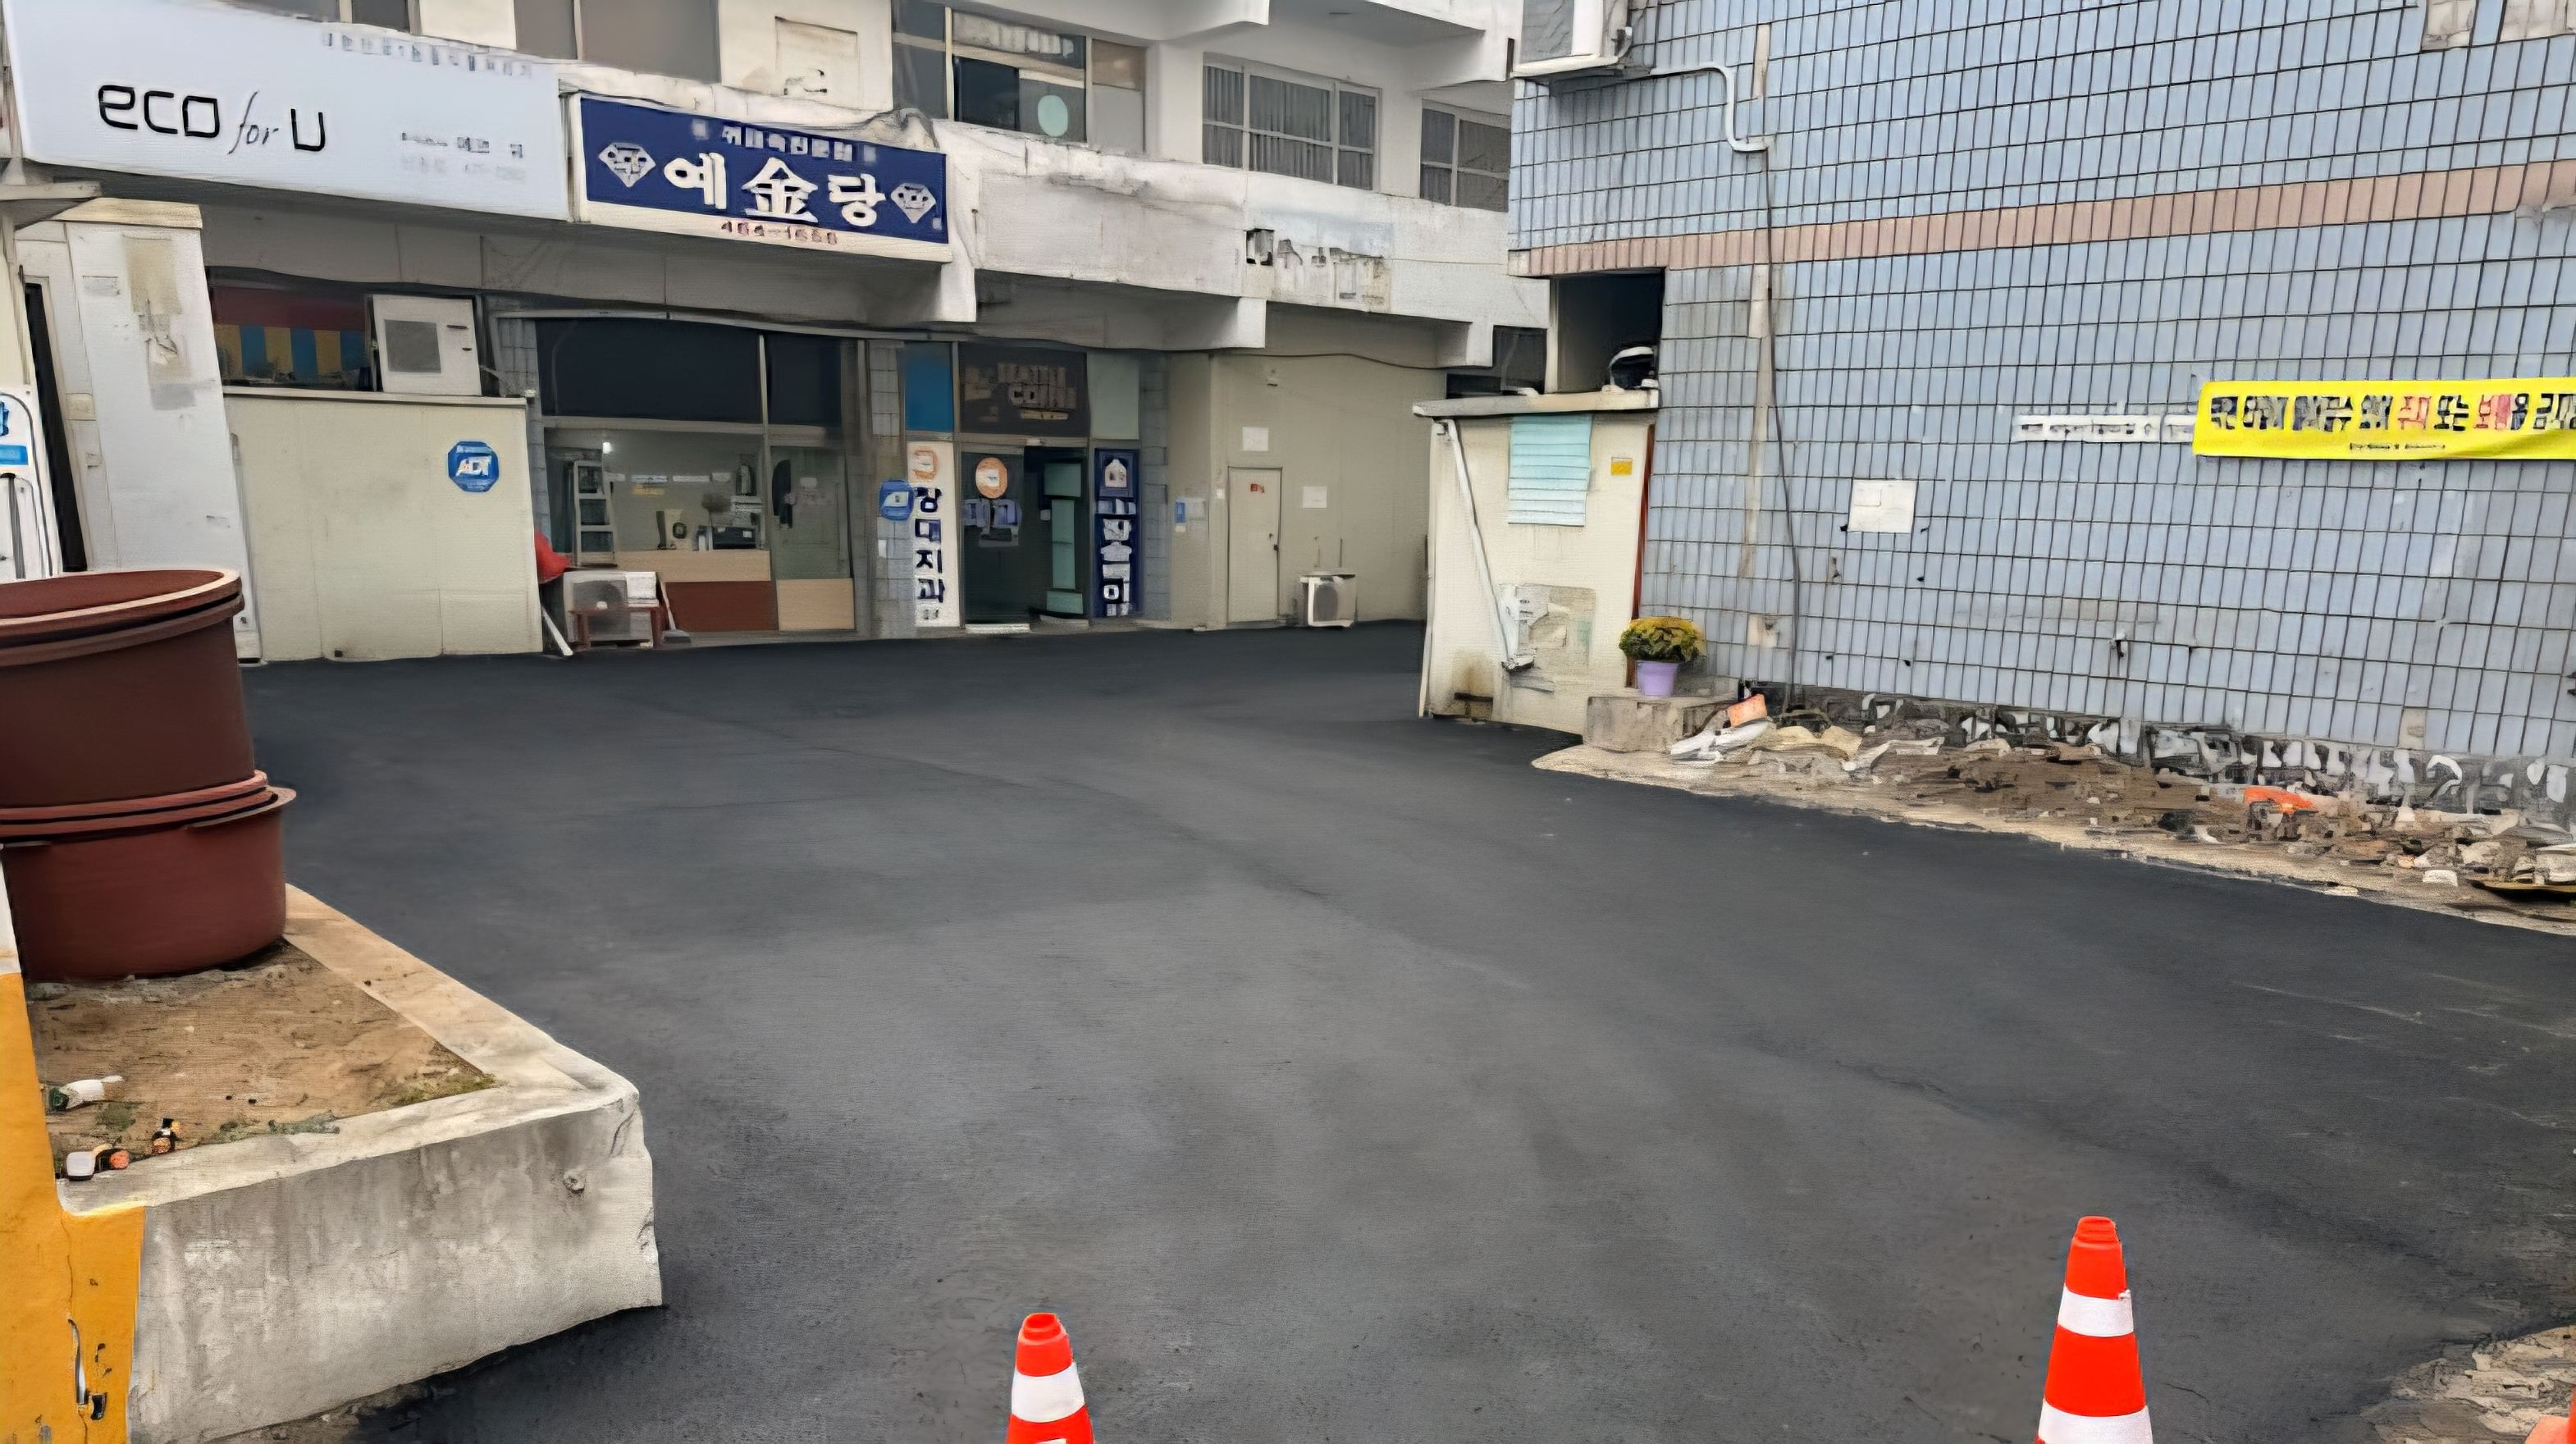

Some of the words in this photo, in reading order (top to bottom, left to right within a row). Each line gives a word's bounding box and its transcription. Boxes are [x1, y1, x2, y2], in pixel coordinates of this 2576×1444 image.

[98, 85, 220, 138] eco
[227, 90, 279, 154] for
[290, 107, 326, 151] U
[665, 153, 886, 227] 예金당
